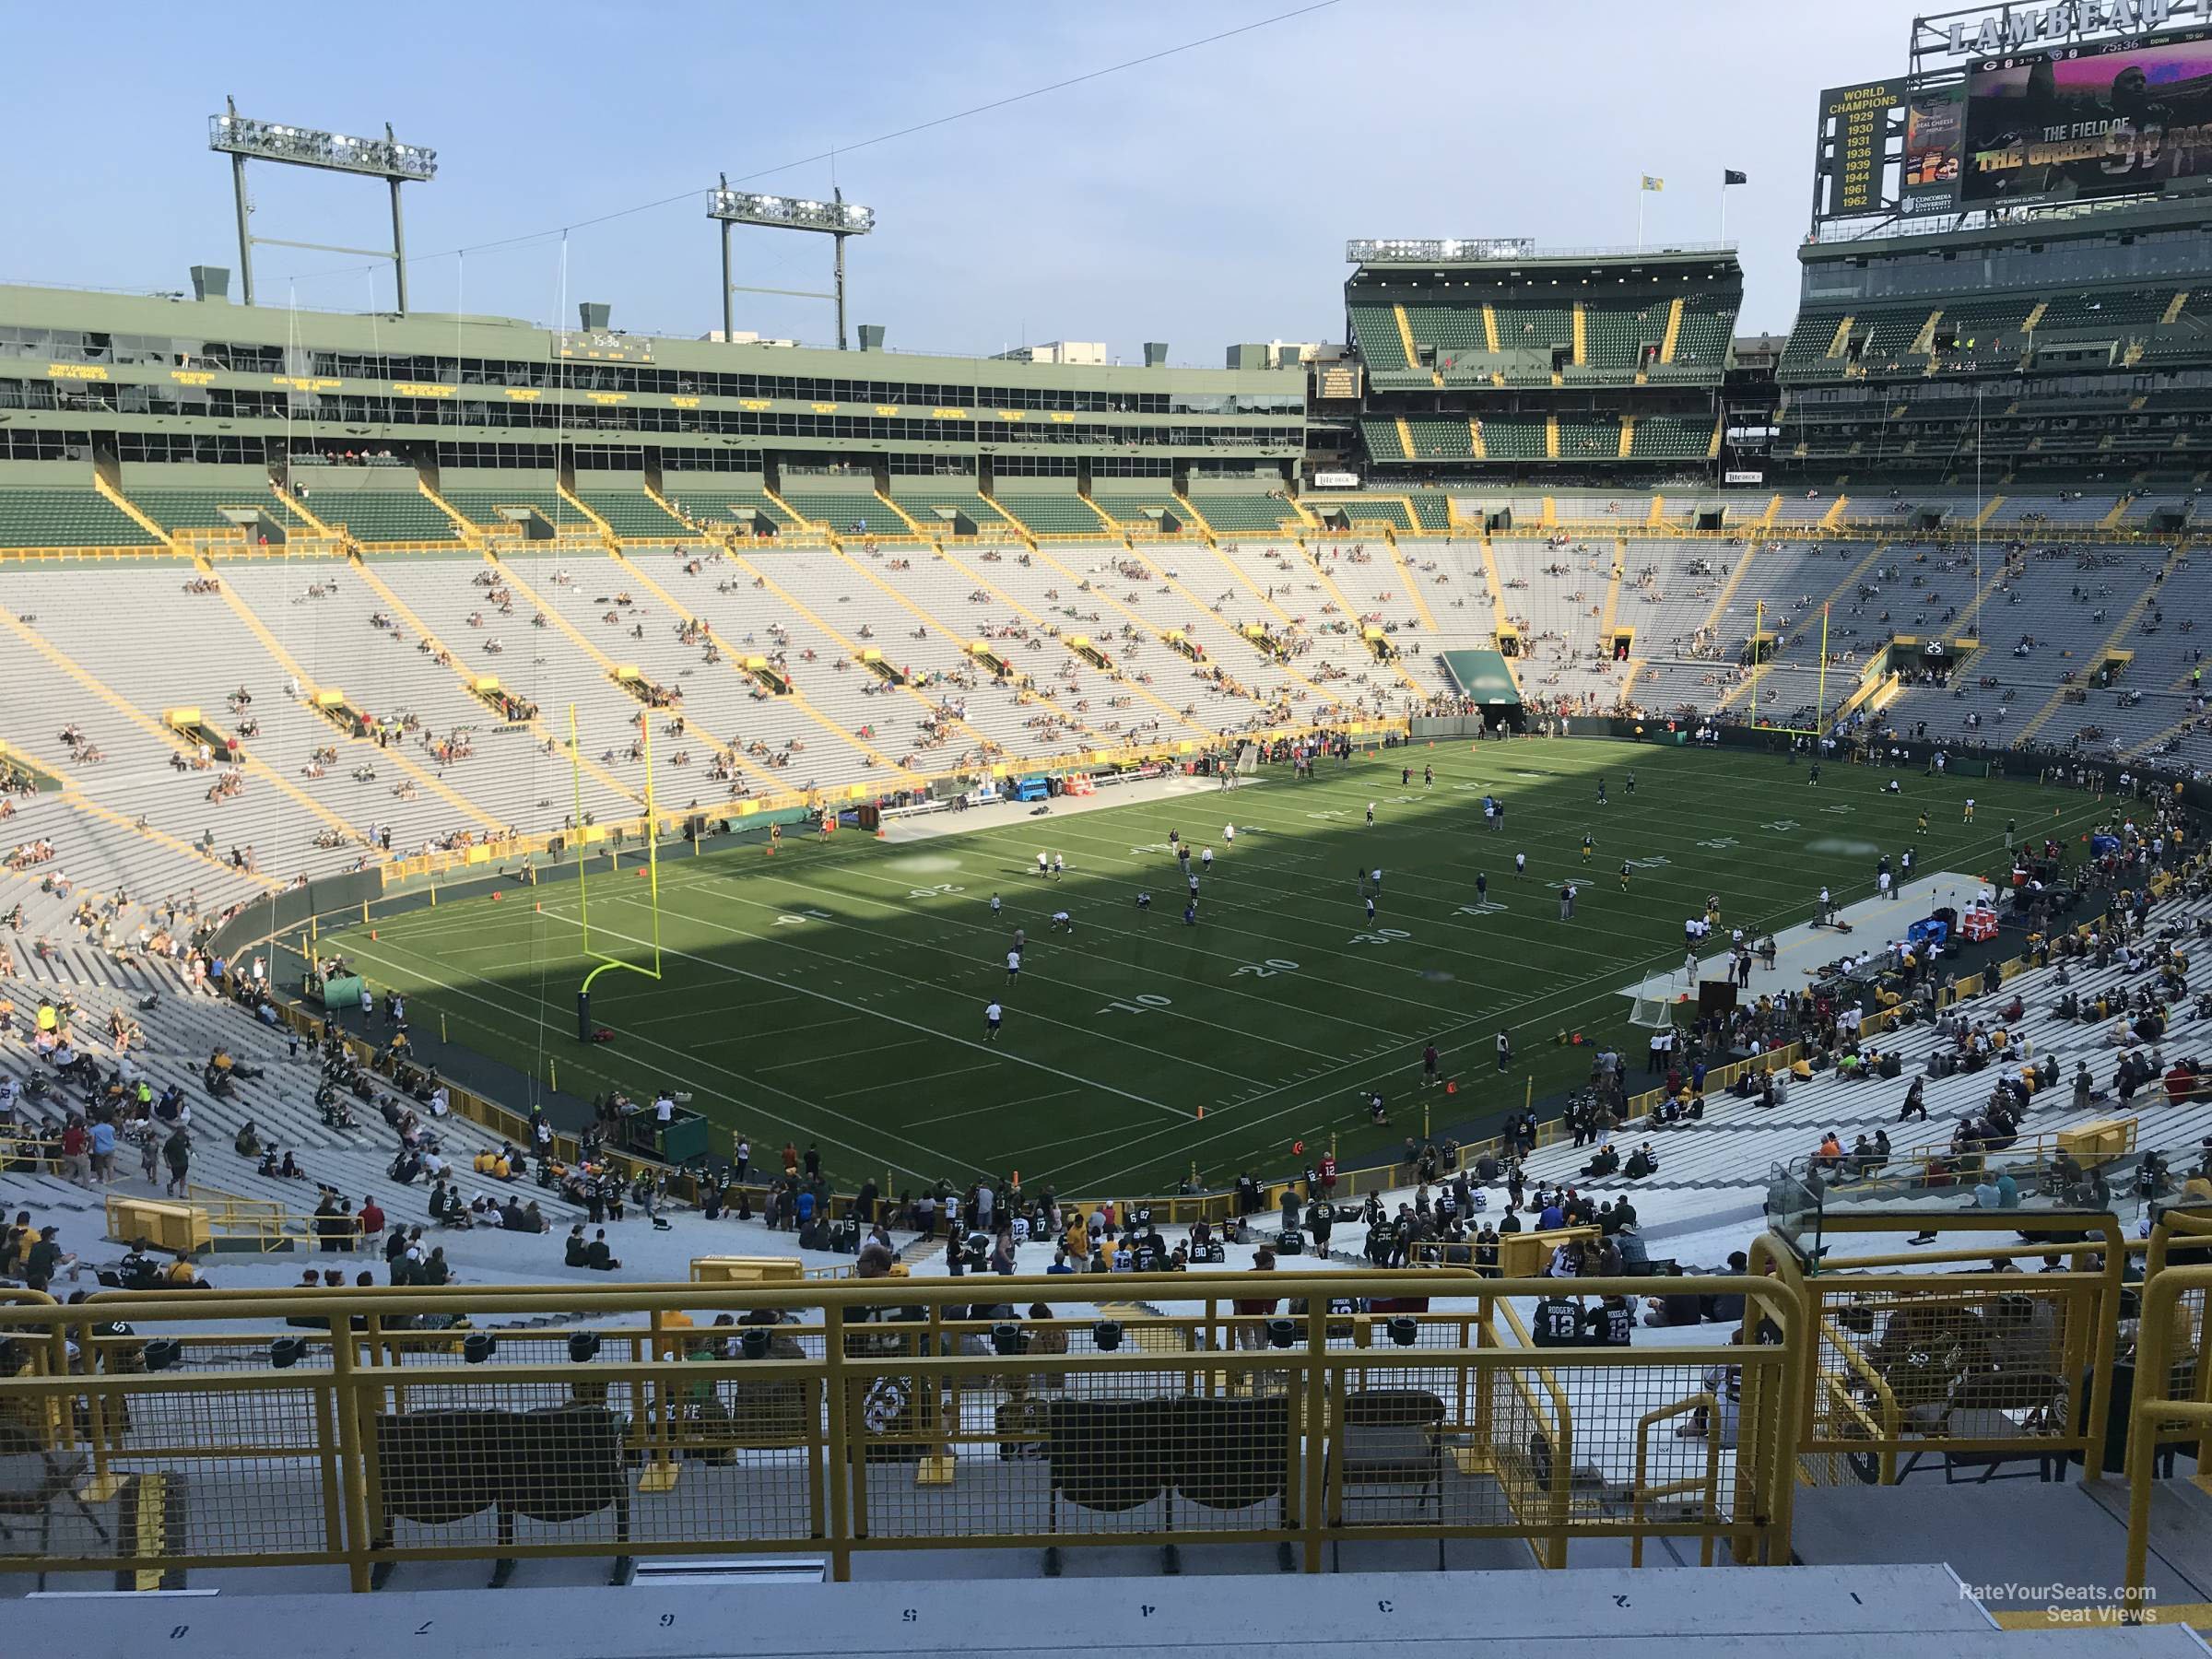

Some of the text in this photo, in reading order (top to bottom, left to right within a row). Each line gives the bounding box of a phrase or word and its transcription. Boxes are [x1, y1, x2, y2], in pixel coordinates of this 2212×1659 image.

[1947, 0, 2170, 55] LAMBEAU
[2101, 40, 2138, 53] 75:36
[1844, 87, 1884, 100] WORLD
[1830, 96, 1897, 113] CHAMPIONS
[1849, 111, 1874, 123] 1929
[1848, 124, 1873, 135] 1930
[2043, 117, 2130, 142] THE FIELD OF
[1847, 135, 1870, 147] 1931
[1846, 147, 1872, 159] 1936
[1976, 147, 2023, 171] THE
[1846, 160, 1871, 171] 1939
[1845, 171, 1870, 182] 1944
[1844, 184, 1866, 195] 1961
[1843, 196, 1867, 207] 1962
[1915, 194, 1951, 203] CONCORDIA
[1915, 200, 1952, 209] UNIVERSITY
[593, 335, 619, 347] 75:36
[1320, 476, 1334, 485] Lite
[1927, 641, 1941, 653] 25
[1545, 878, 1594, 888] 50
[910, 882, 965, 898] 20
[1459, 901, 1509, 915] 40
[777, 910, 832, 924] 10
[1354, 928, 1411, 944] 30
[1238, 959, 1300, 977] 20
[1108, 994, 1172, 1014] 10
[1325, 1166, 1335, 1176] 12
[1477, 1196, 1487, 1206] 52
[1140, 1210, 1149, 1219] 87
[844, 1219, 855, 1231] 15
[1014, 1224, 1024, 1235] 12
[1037, 1221, 1046, 1231] 17
[1548, 1306, 1575, 1315] RODGERS
[1607, 1309, 1629, 1319] RODGERS
[1548, 1314, 1574, 1337] 12
[1607, 1318, 1630, 1343] 12
